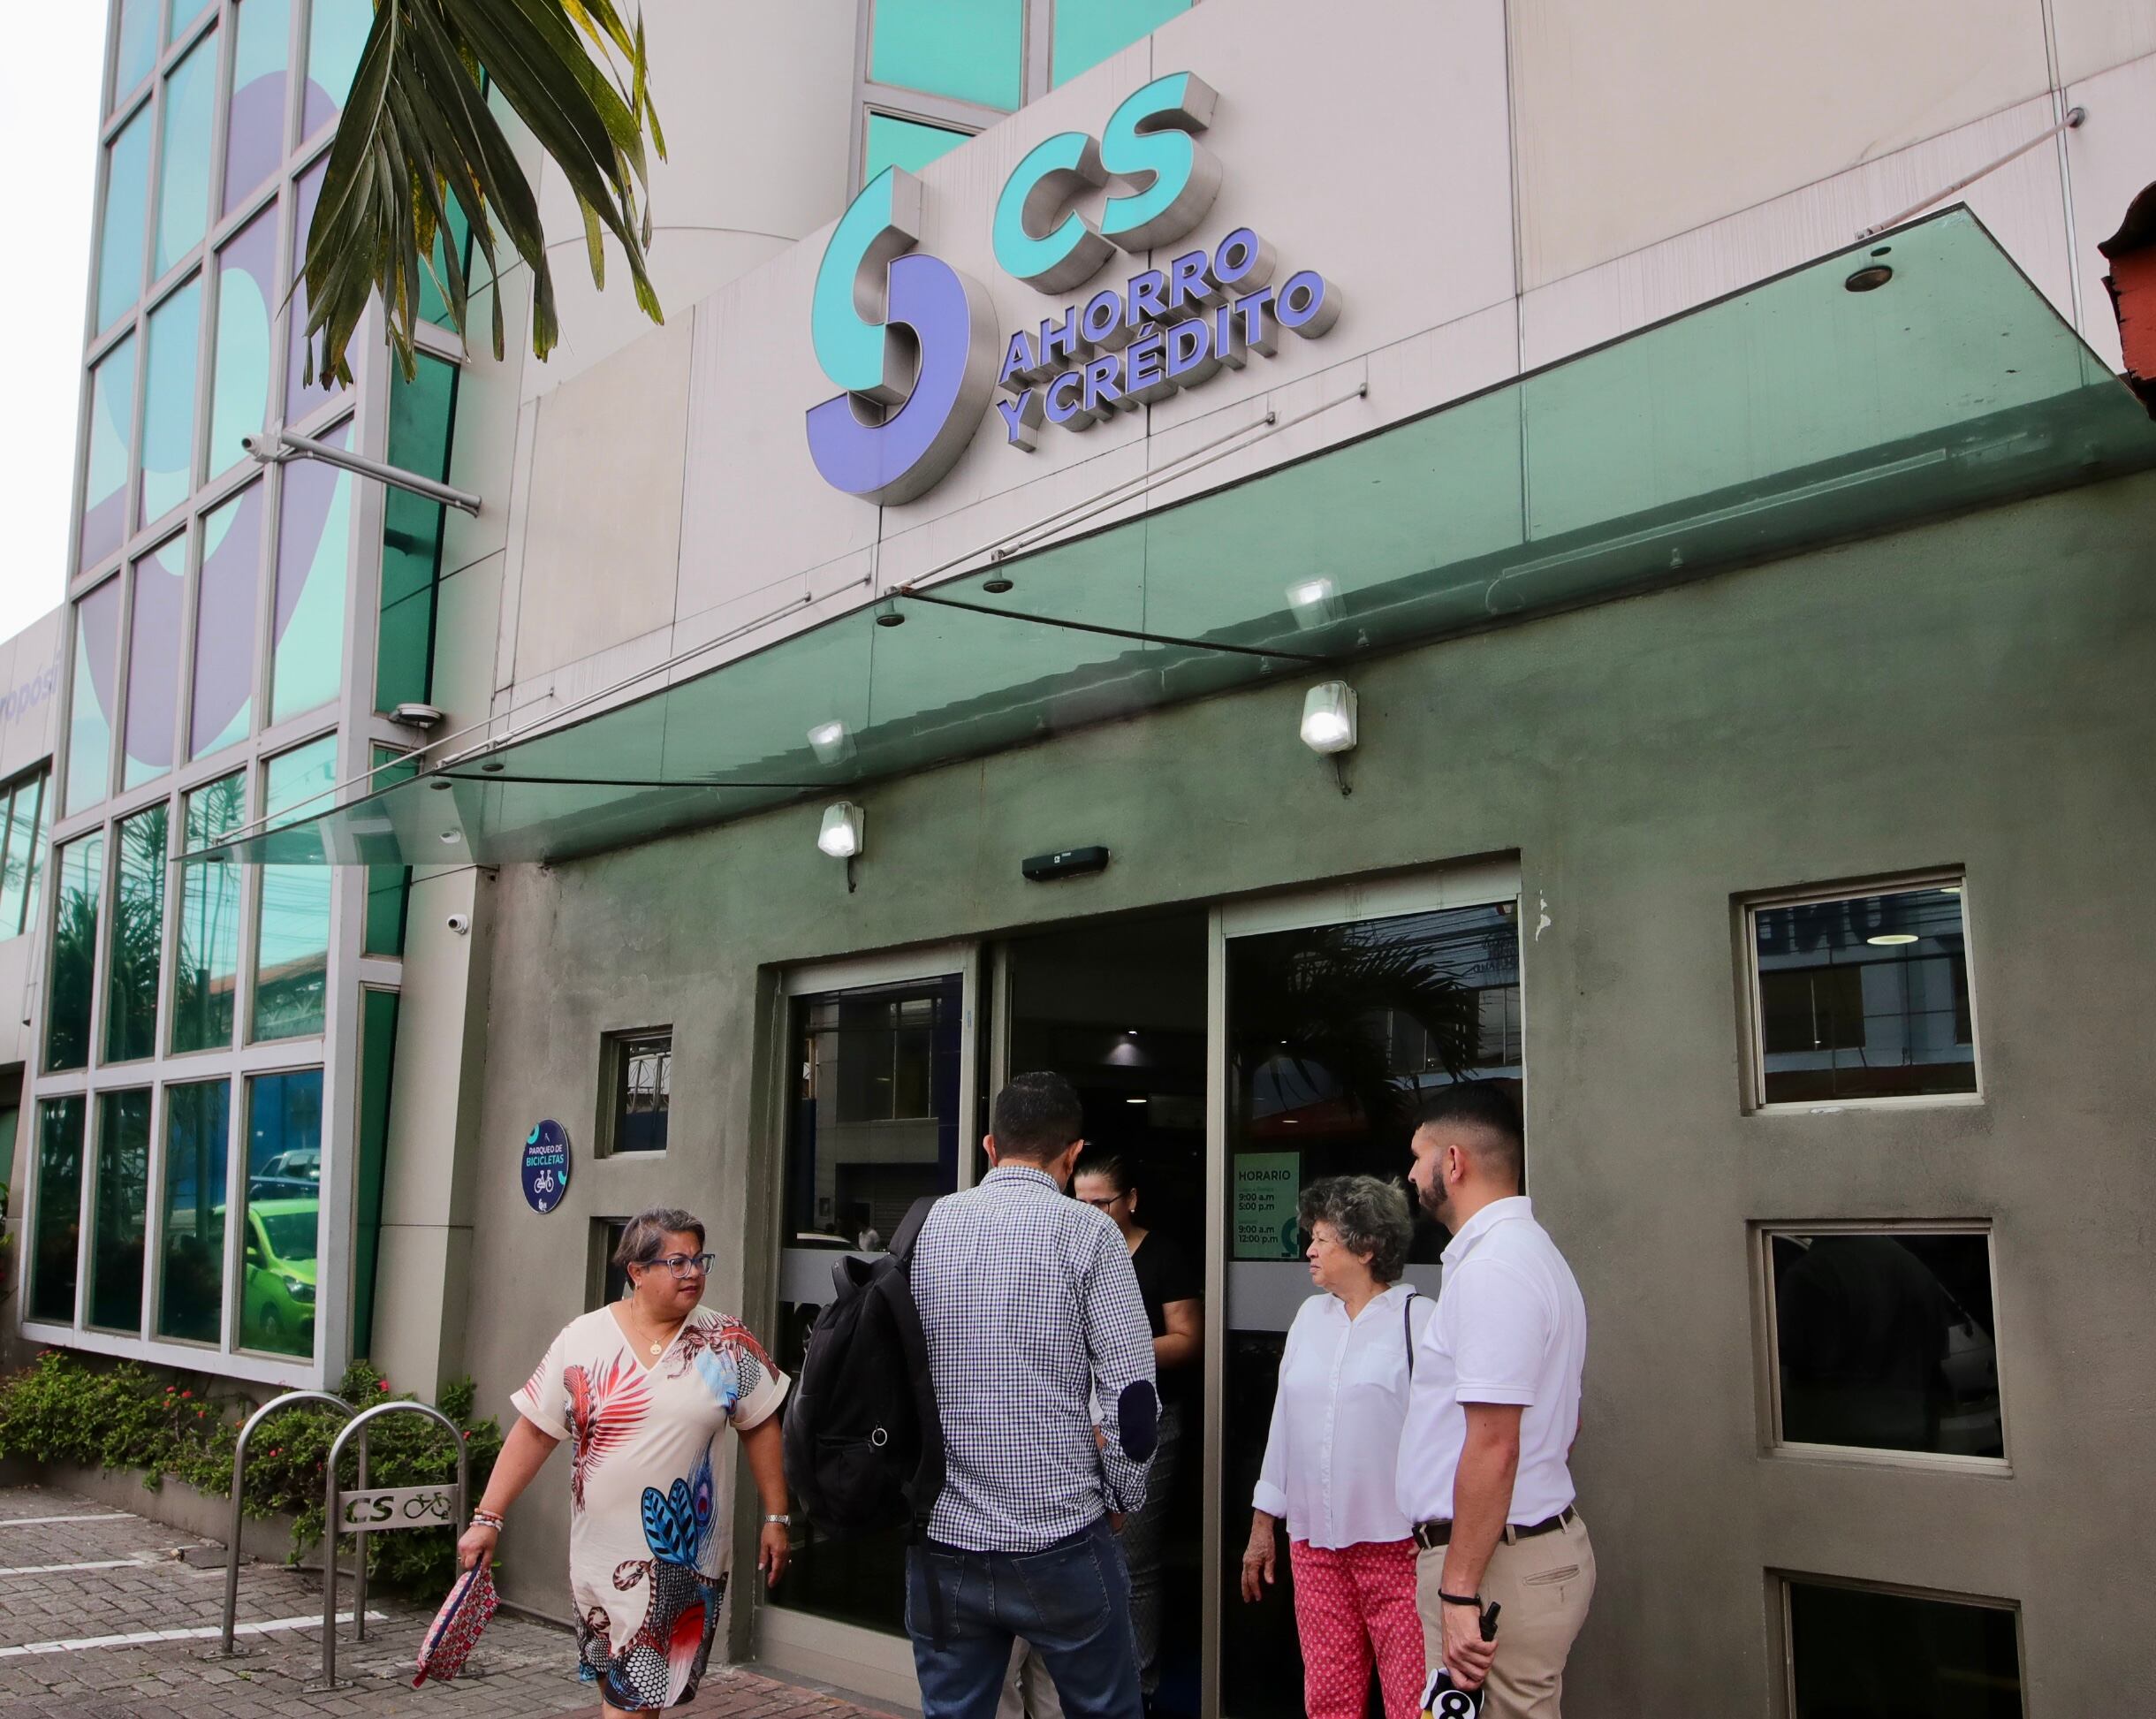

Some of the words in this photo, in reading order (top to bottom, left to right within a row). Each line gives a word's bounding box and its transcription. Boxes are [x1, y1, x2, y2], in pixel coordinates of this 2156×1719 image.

[992, 71, 1200, 281] CS
[999, 227, 1262, 387] AHORRO
[997, 387, 1034, 444] Y
[1044, 270, 1327, 424] CRÉDITO
[526, 1154, 565, 1167] BICICLETAS
[528, 1145, 555, 1155] PARQUEO
[555, 1144, 563, 1153] DE
[1239, 1170, 1291, 1181] HORARIO
[345, 1496, 394, 1524] CS
[1439, 1692, 1470, 1719] 8
